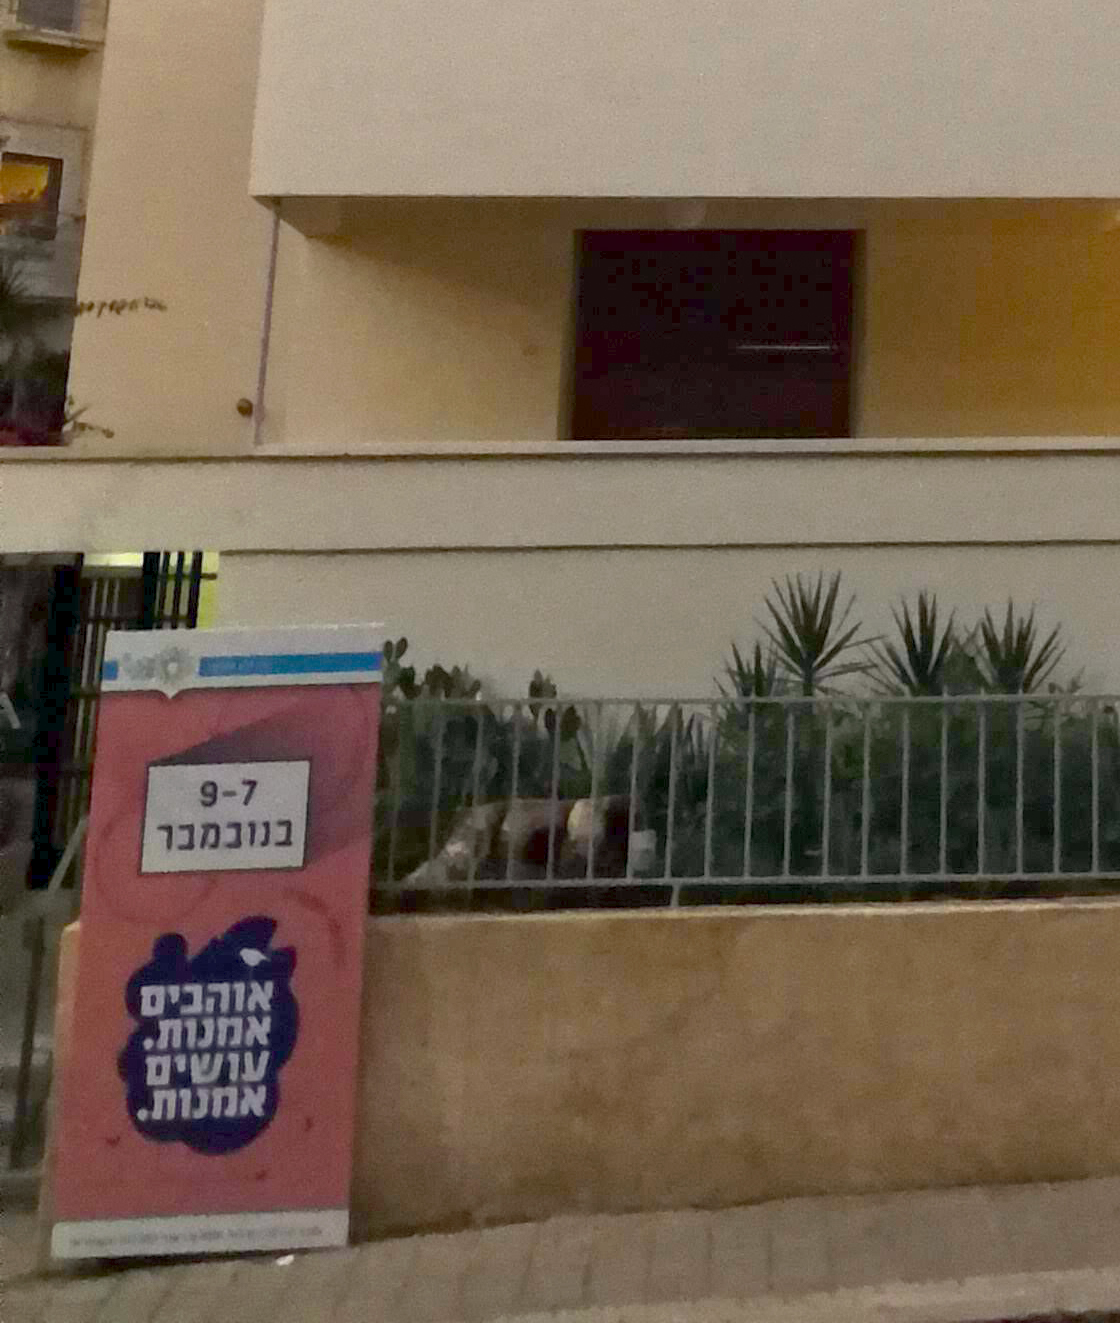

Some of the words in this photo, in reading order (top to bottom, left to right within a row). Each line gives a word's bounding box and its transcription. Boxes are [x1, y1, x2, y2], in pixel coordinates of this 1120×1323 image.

[157, 819, 292, 850] בנובמבר
[140, 980, 274, 1017] אוהבים
[142, 1014, 272, 1050] אמנות.
[145, 1050, 270, 1086] עושים
[136, 1085, 267, 1121] אמנות.
